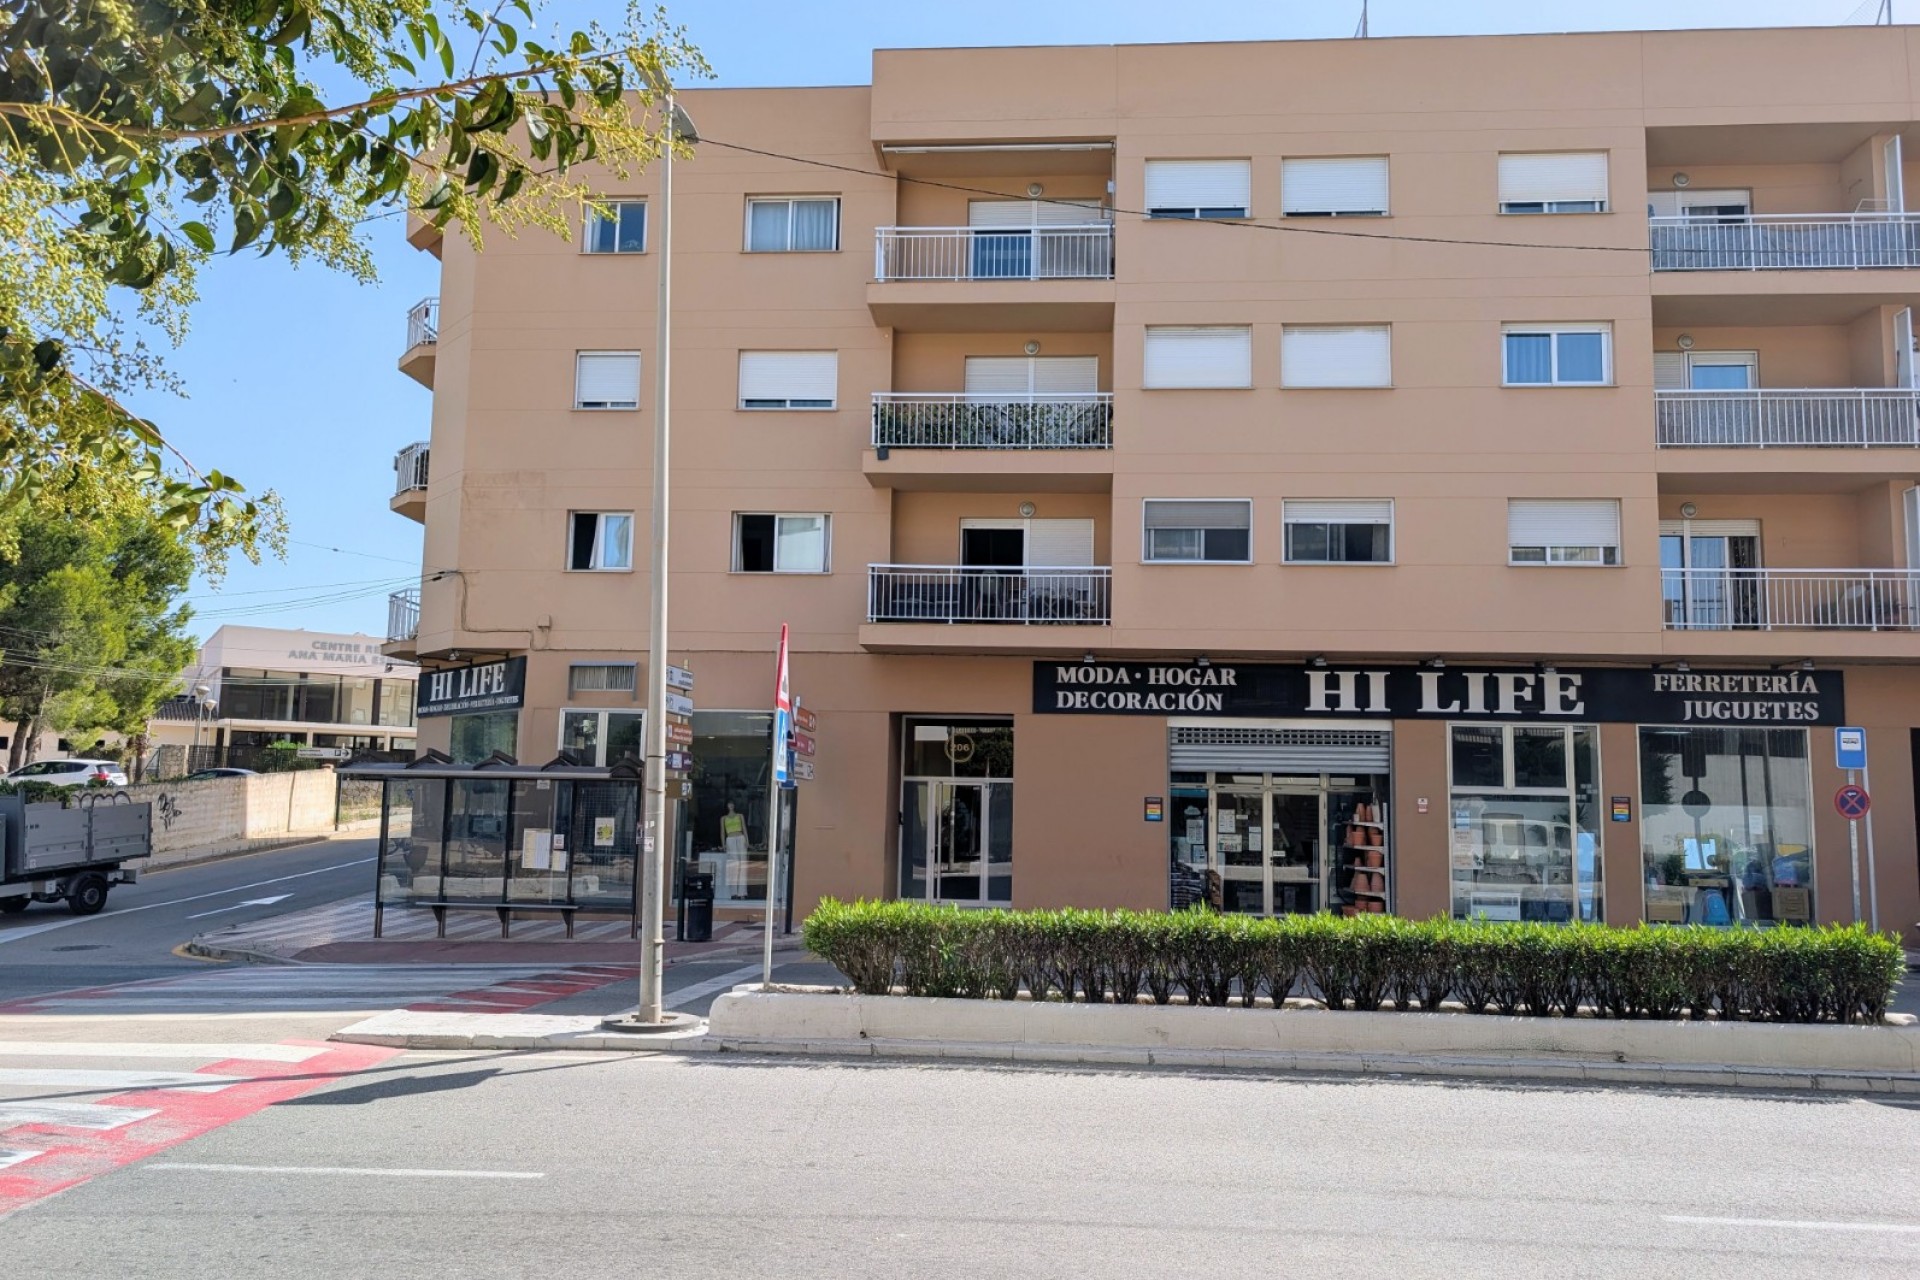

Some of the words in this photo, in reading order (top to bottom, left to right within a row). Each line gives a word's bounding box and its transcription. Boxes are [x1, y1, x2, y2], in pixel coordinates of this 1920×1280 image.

[288, 649, 318, 660] ANA
[323, 652, 367, 664] MARIA
[312, 641, 360, 652] CENTRE
[365, 644, 381, 655] RE
[430, 671, 454, 702] HI
[459, 662, 506, 698] LIFE
[1056, 666, 1131, 684] MODA
[1147, 667, 1237, 686] HOGAR
[1653, 671, 1820, 694] FERRETERÍA
[1056, 689, 1223, 711] DECORACIÓN
[1304, 671, 1391, 712] HI
[1416, 672, 1585, 715] LIFE
[1683, 700, 1819, 721] JUGUETES
